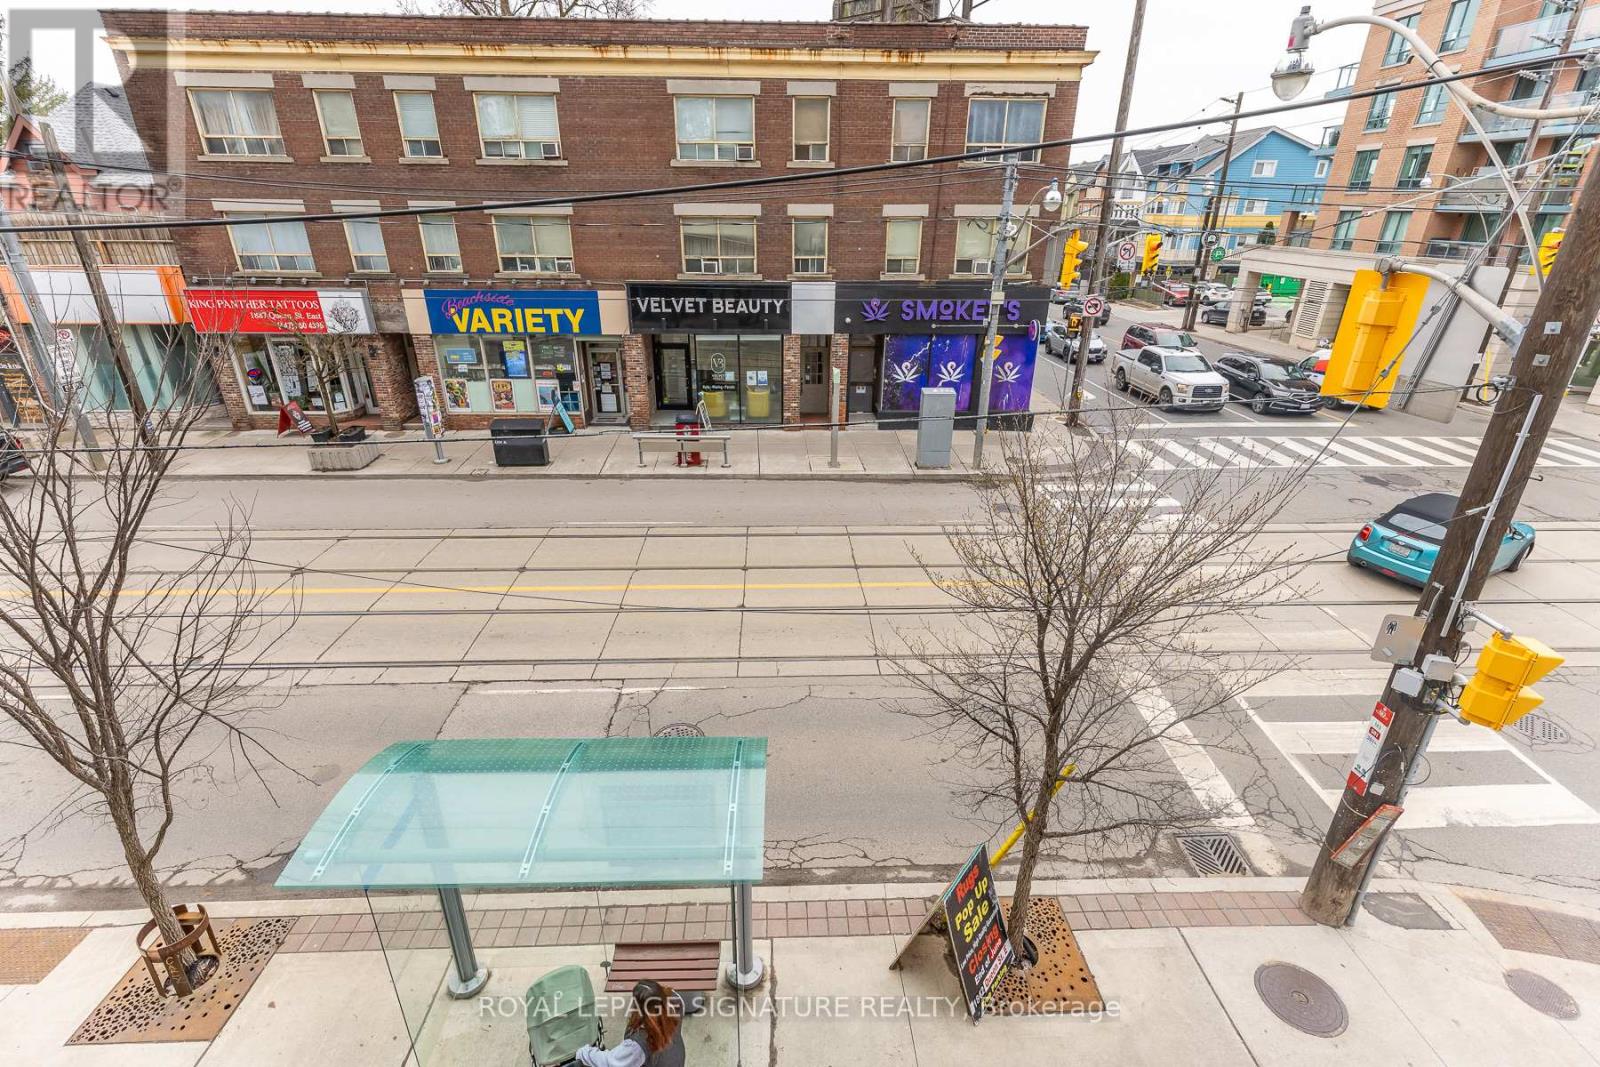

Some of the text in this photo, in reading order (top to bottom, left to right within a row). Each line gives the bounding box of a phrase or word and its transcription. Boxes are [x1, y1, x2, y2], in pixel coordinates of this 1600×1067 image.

[188, 299, 320, 310] KING PANTHER TATTOOS
[306, 312, 322, 320] East
[442, 291, 514, 319] Beachside
[636, 297, 785, 314] VELVET BEAUTY
[901, 299, 1020, 321] SMOKE'S
[450, 308, 585, 333] VARIETY
[955, 864, 979, 904] Rugs
[955, 876, 988, 931] Pop Up
[963, 900, 989, 943] Sale
[968, 922, 1001, 975] Closing
[974, 963, 985, 986] End
